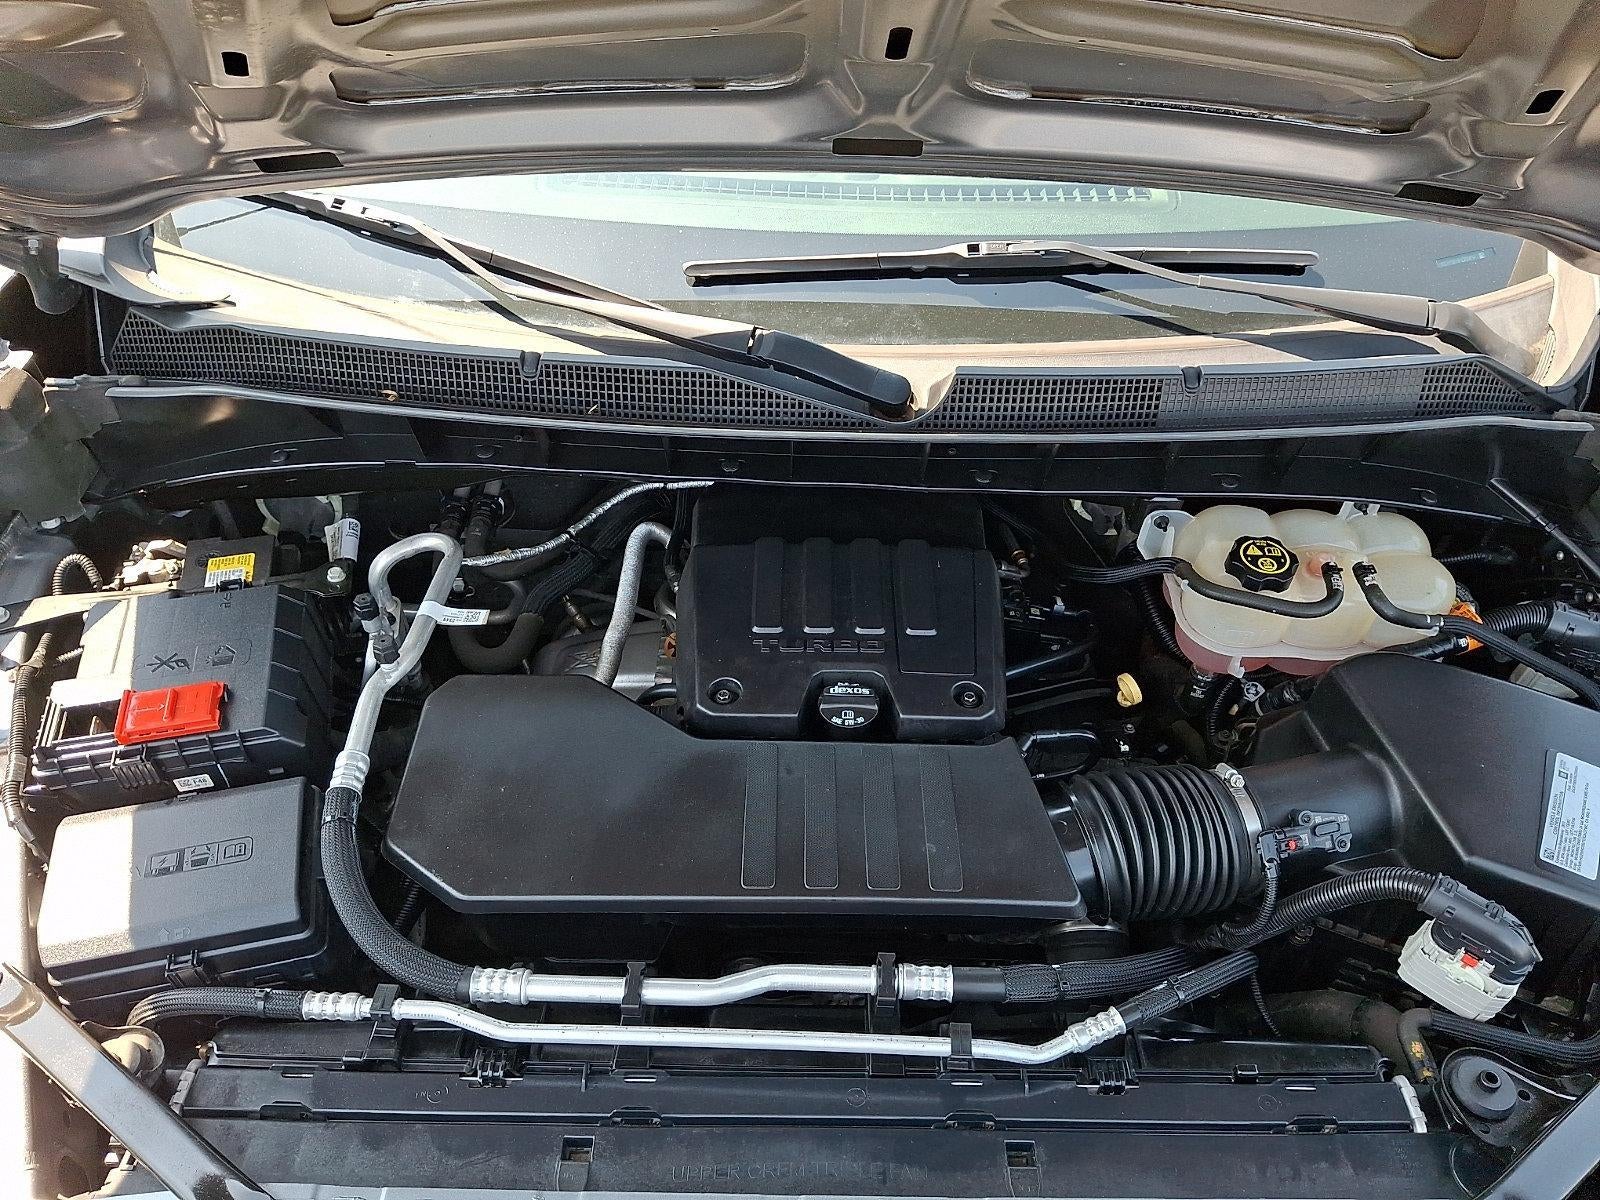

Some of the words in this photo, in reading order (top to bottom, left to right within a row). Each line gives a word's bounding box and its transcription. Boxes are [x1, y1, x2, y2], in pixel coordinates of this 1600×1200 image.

[752, 639, 885, 654] TURBO
[829, 685, 870, 695] dexos
[831, 716, 843, 725] SAE
[671, 1164, 741, 1182] UPPER
